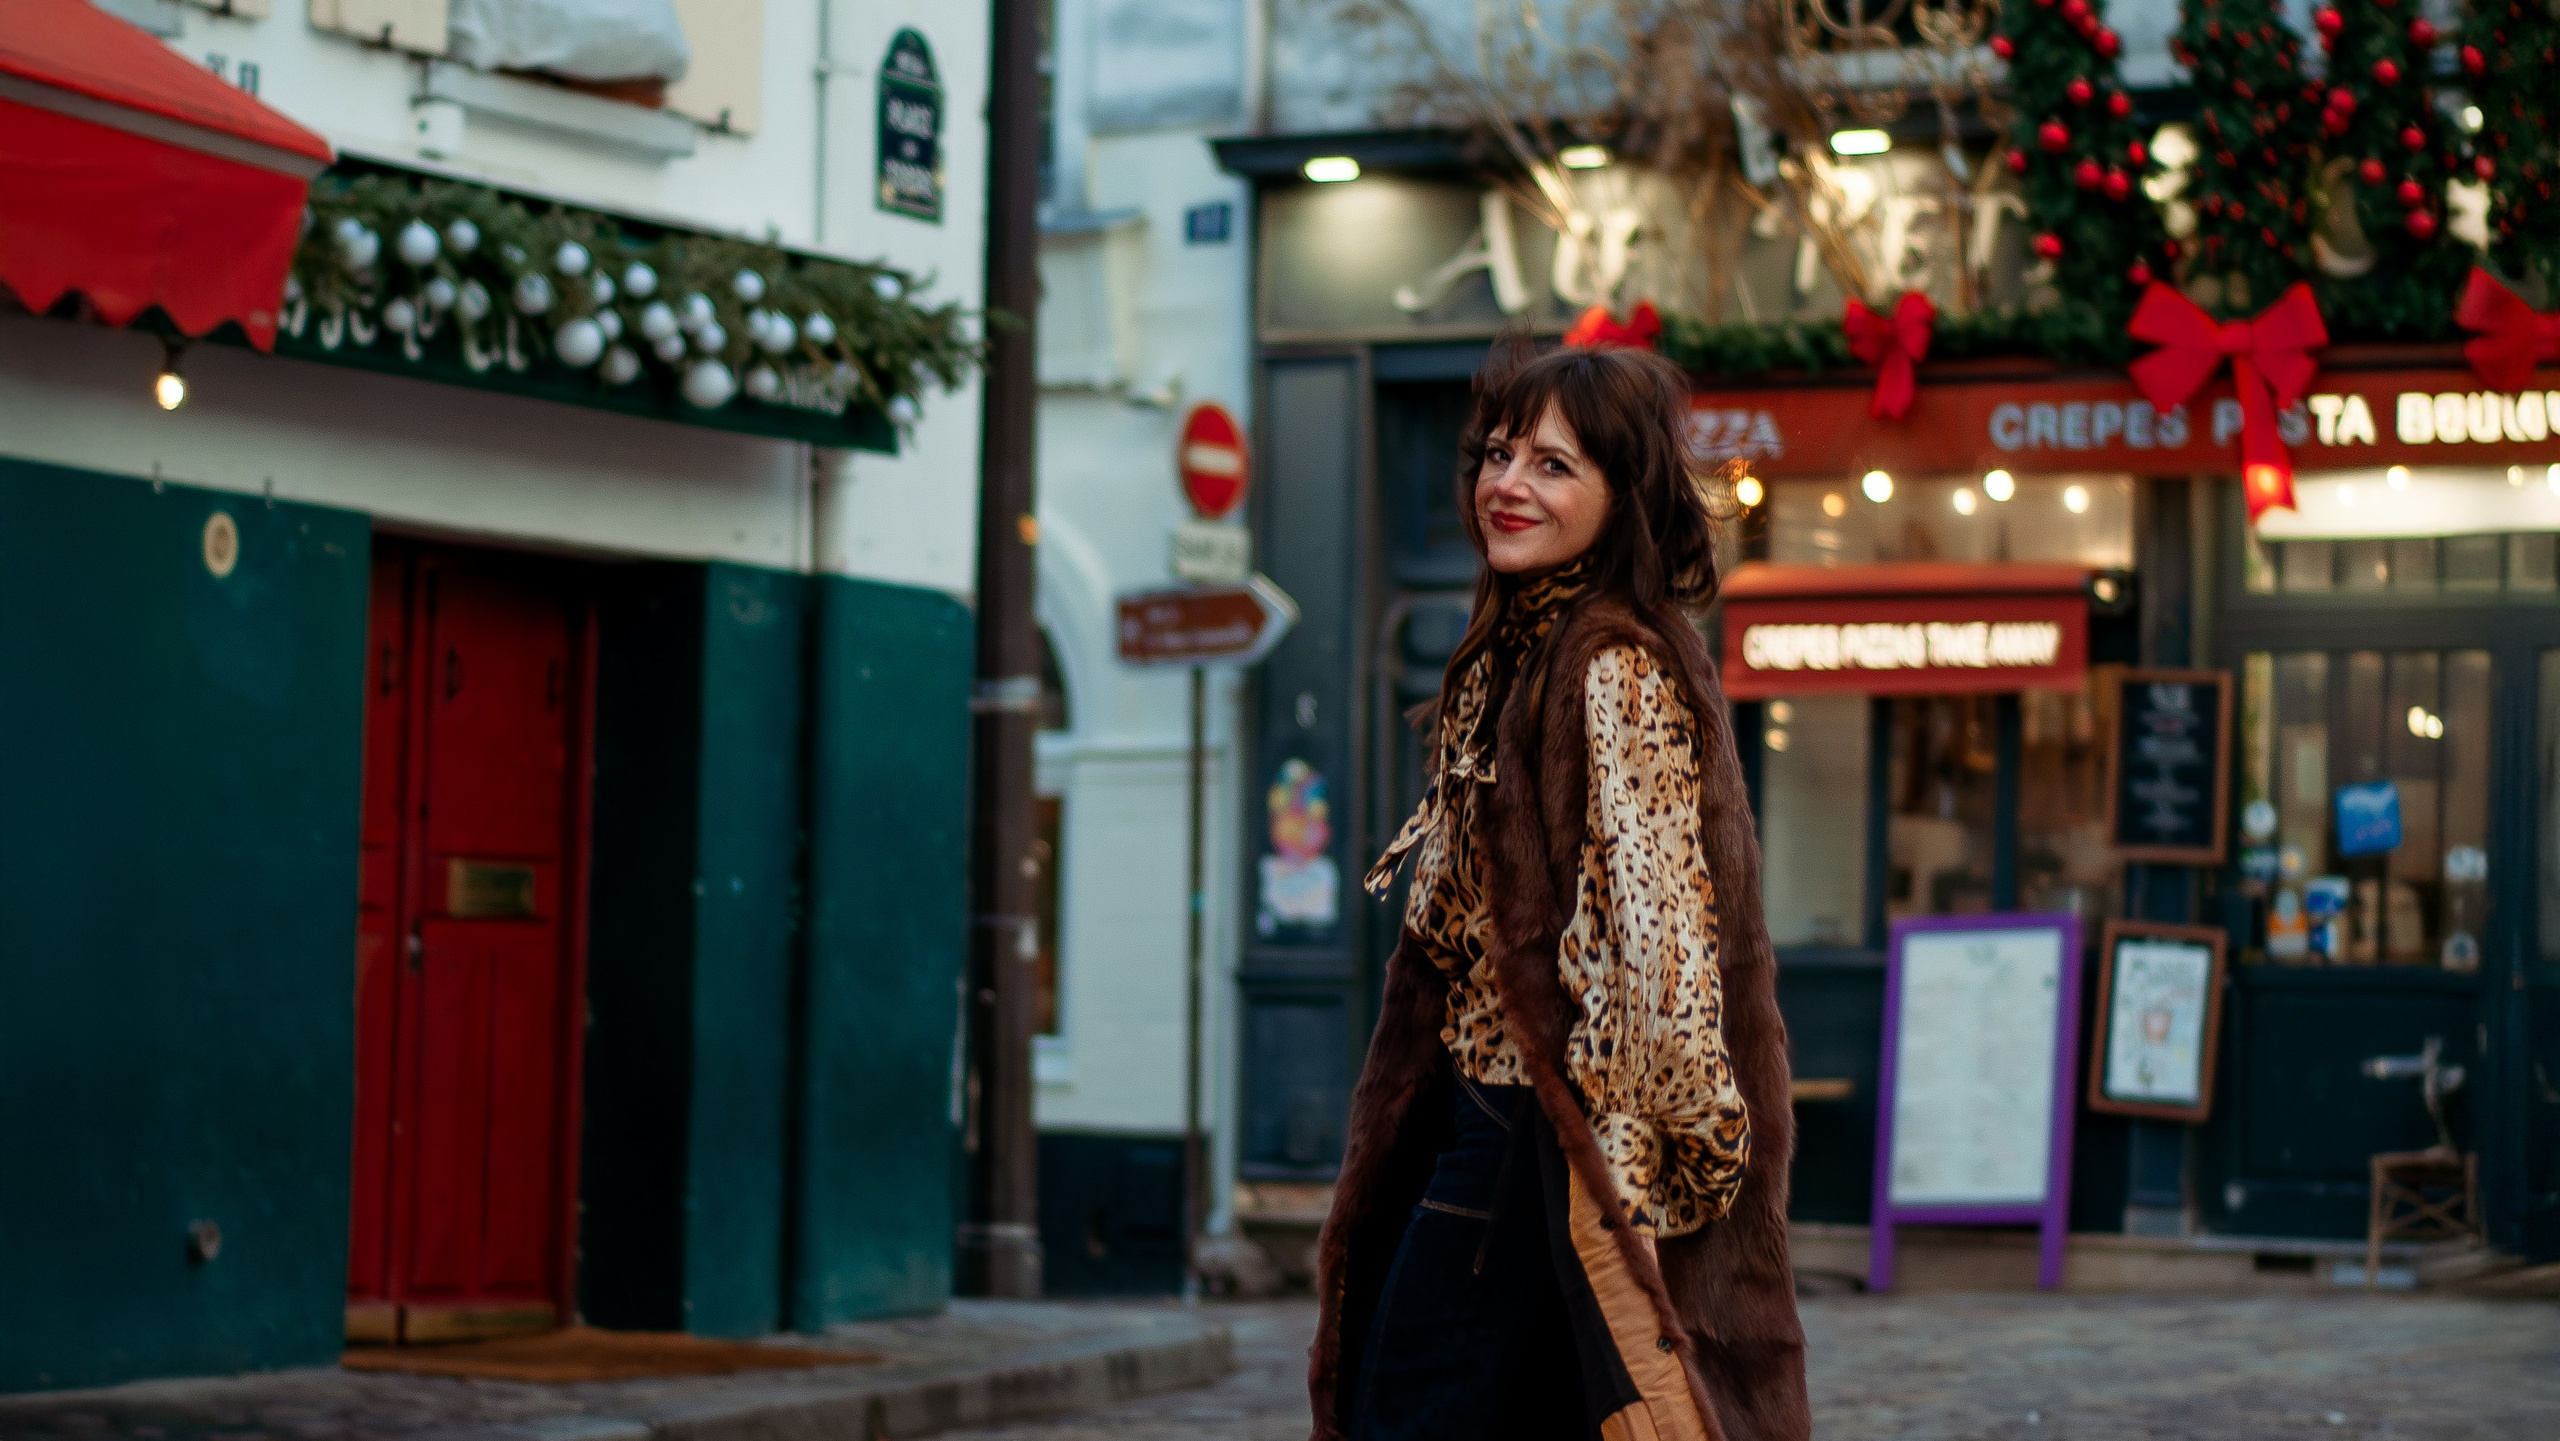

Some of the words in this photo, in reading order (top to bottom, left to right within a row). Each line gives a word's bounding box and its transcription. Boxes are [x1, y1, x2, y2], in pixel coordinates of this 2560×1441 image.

[1685, 408, 1785, 460] ZZA
[1988, 401, 2189, 450] CREPES
[2211, 394, 2378, 448] PSTA
